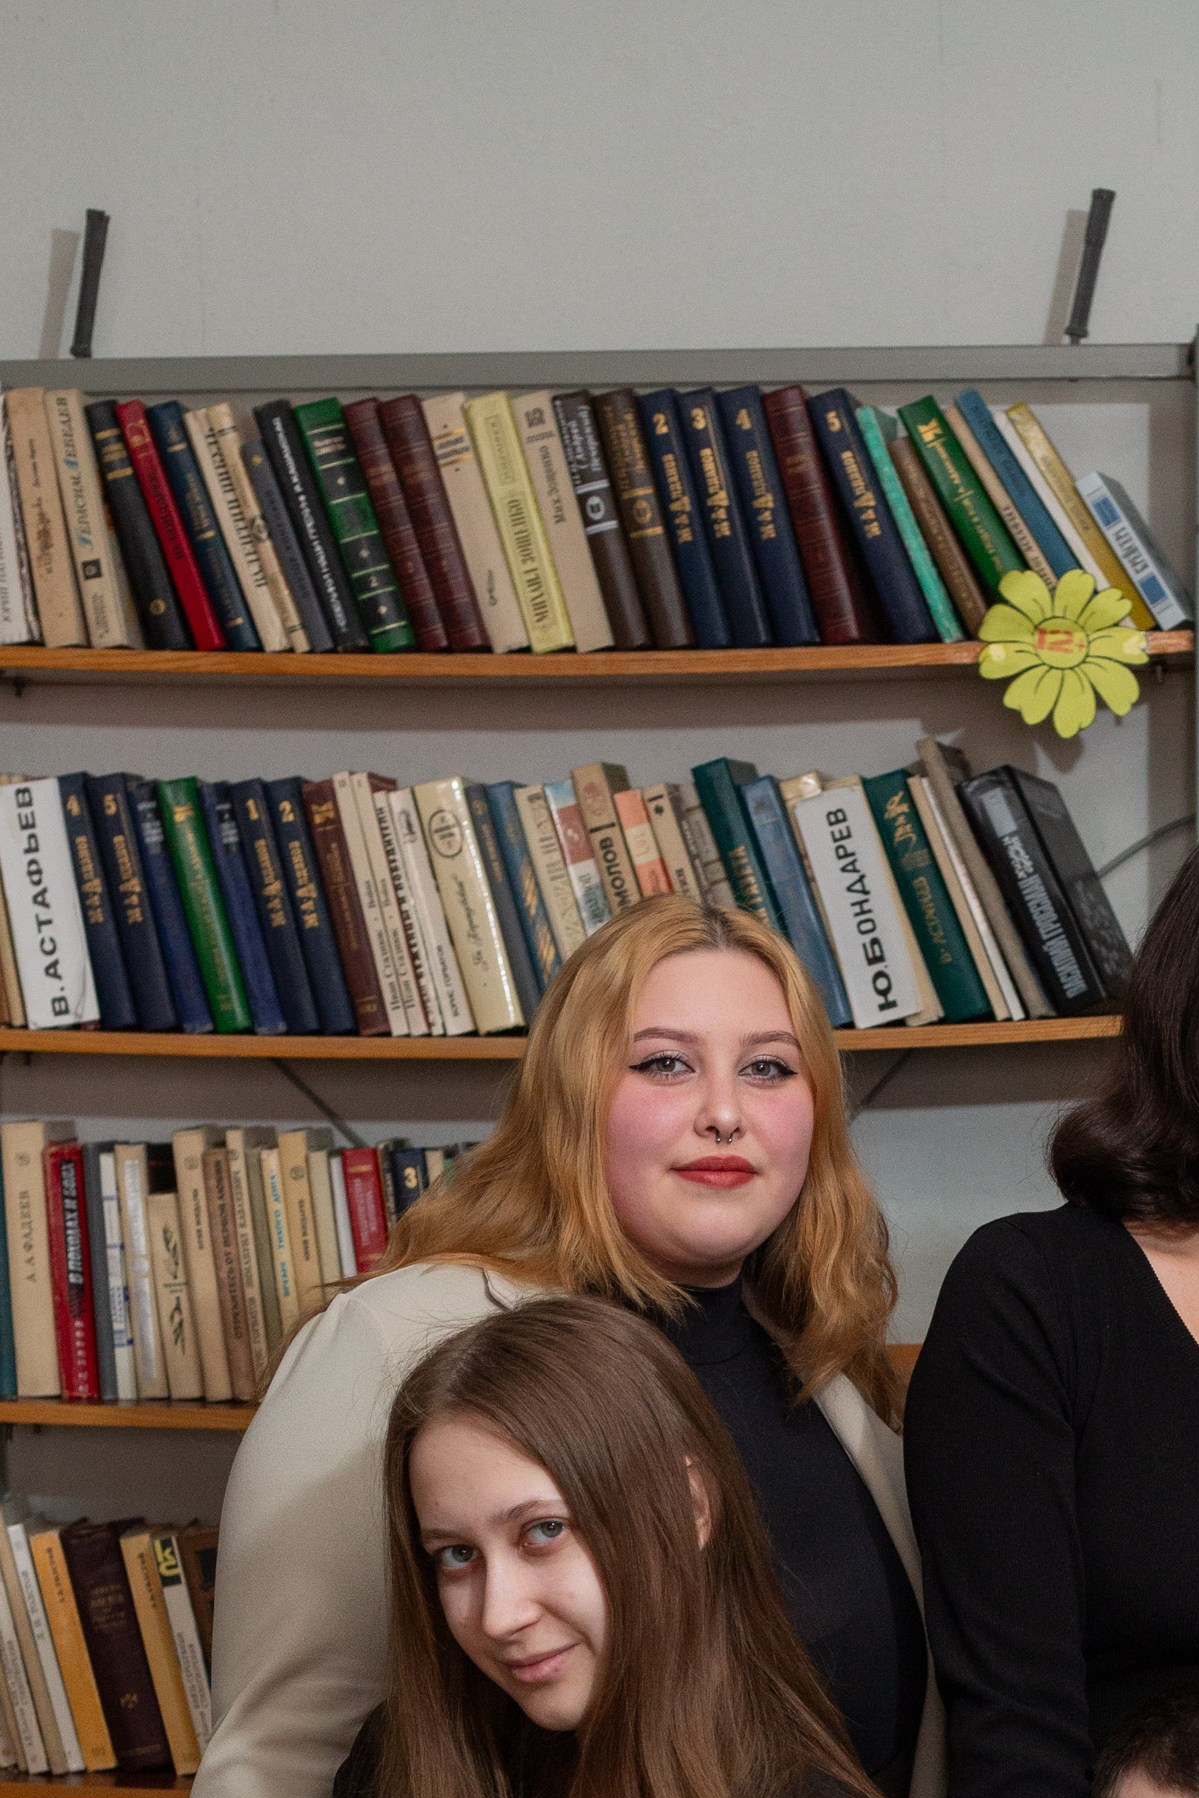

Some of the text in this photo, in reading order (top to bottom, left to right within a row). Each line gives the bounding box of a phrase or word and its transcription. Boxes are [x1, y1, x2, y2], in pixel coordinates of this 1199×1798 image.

[651, 411, 669, 435] 2
[689, 405, 707, 431] 3
[732, 407, 753, 432] 4
[823, 408, 843, 434] 5
[503, 497, 552, 623] МИХАИЛ ЗОЩЕНКО
[62, 793, 82, 817] 4
[100, 792, 119, 817] 5
[243, 797, 260, 821] 1
[277, 798, 295, 824] 2
[1017, 874, 1088, 999] ВАСИЛИЙ ГРОССМАН
[384, 980, 401, 1011] Иван
[399, 978, 416, 1009] Иван
[404, 1167, 418, 1189] 3
[17, 1189, 35, 1252] ФАДЕЕВ
[63, 1209, 83, 1271] ПОХОДАХ
